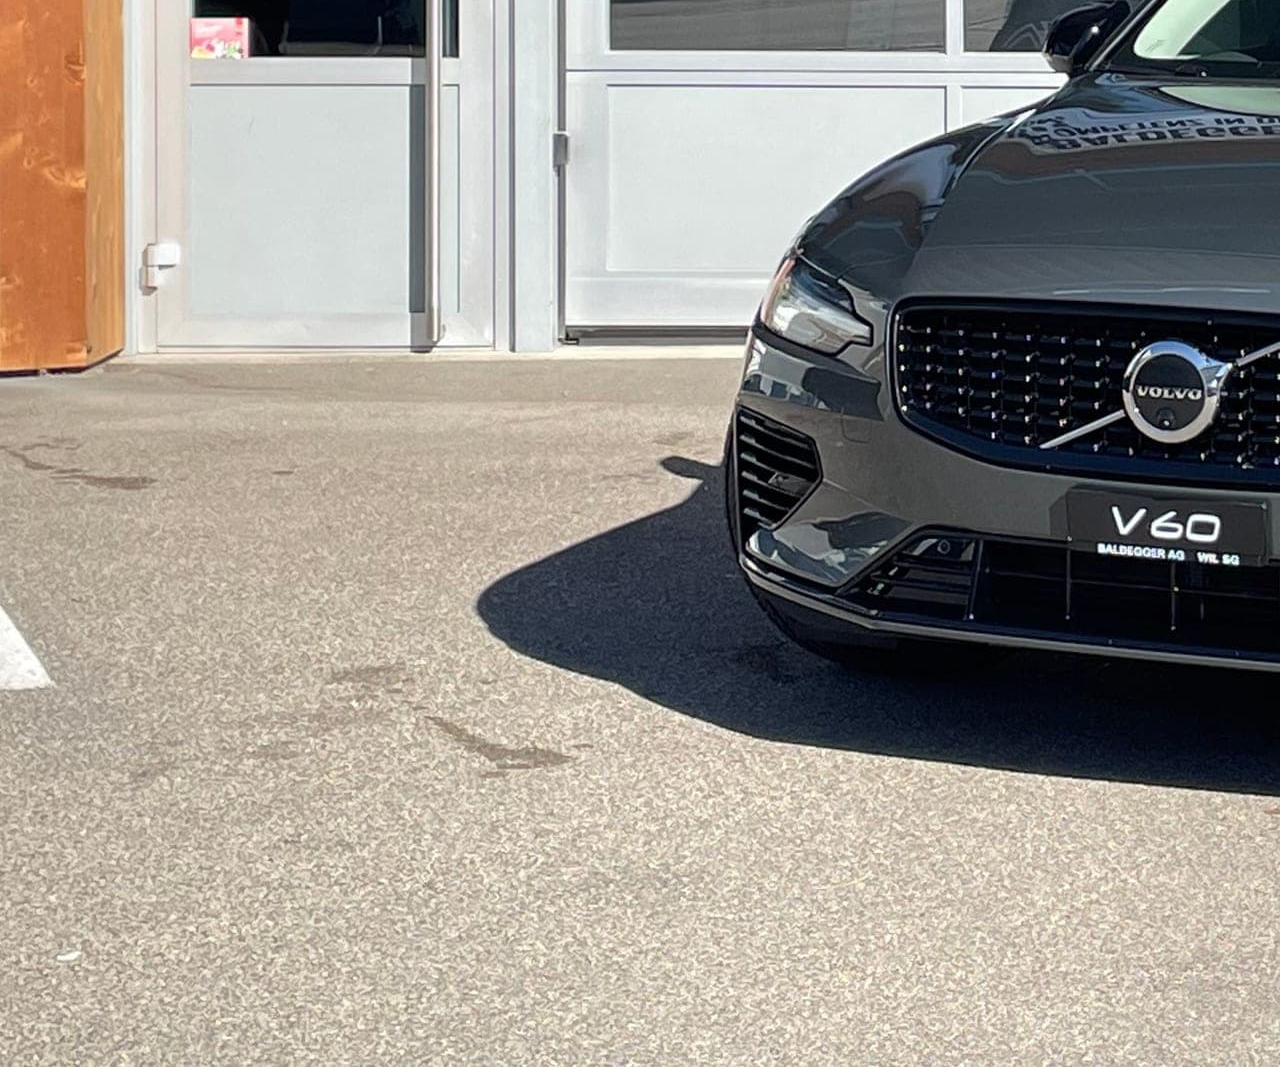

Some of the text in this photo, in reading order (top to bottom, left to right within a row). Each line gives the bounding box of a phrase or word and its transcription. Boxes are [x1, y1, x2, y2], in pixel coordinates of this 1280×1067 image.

[1136, 385, 1202, 400] VOLVO
[1097, 543, 1240, 566] BALDEGGER AG WIL SG
